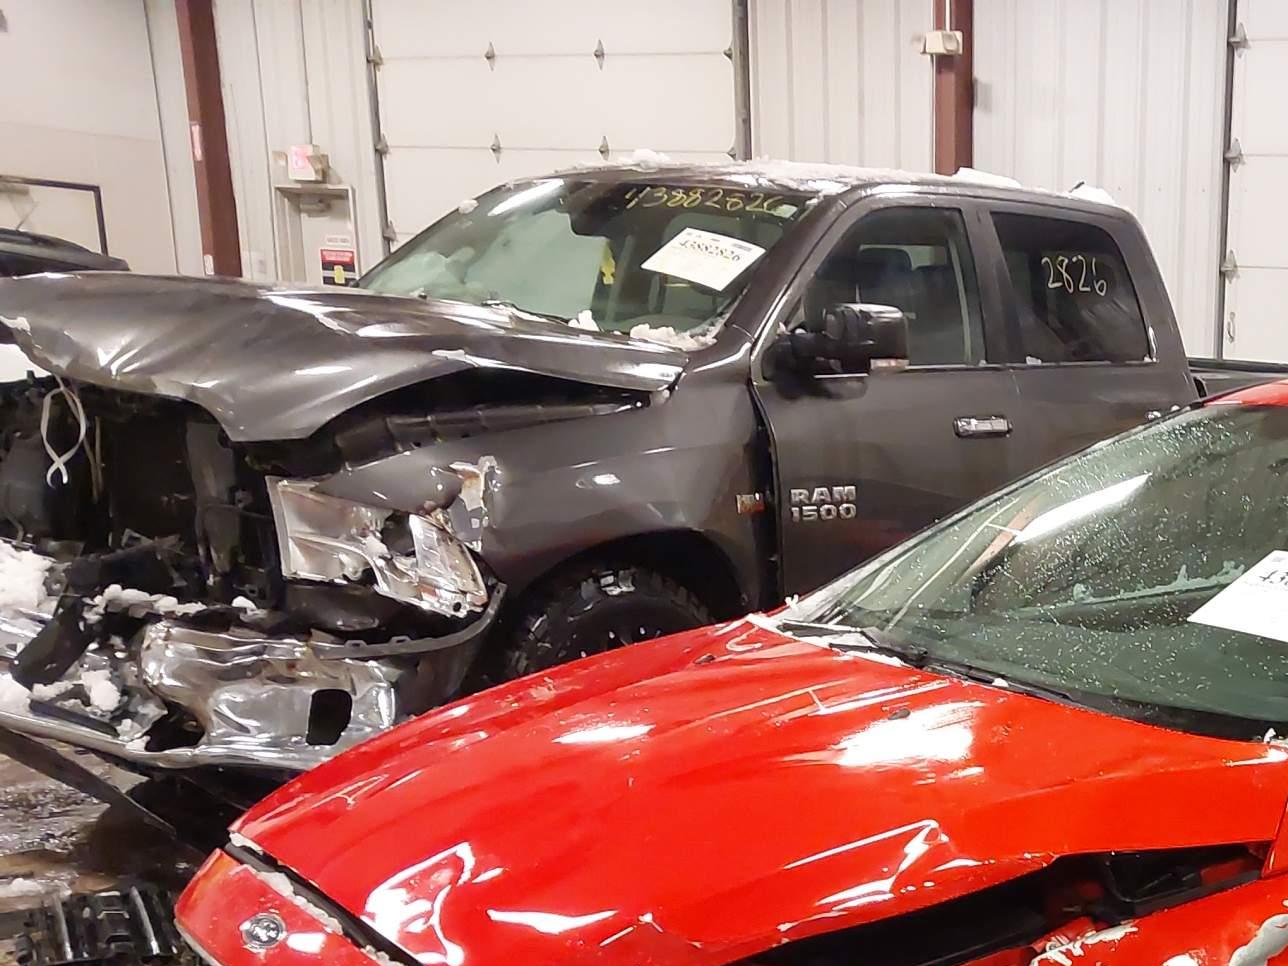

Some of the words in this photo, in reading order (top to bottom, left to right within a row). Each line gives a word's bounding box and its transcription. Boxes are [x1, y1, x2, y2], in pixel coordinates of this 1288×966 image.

[1041, 255, 1107, 297] 2826
[790, 485, 856, 503] RAM
[791, 503, 857, 521] 1500
